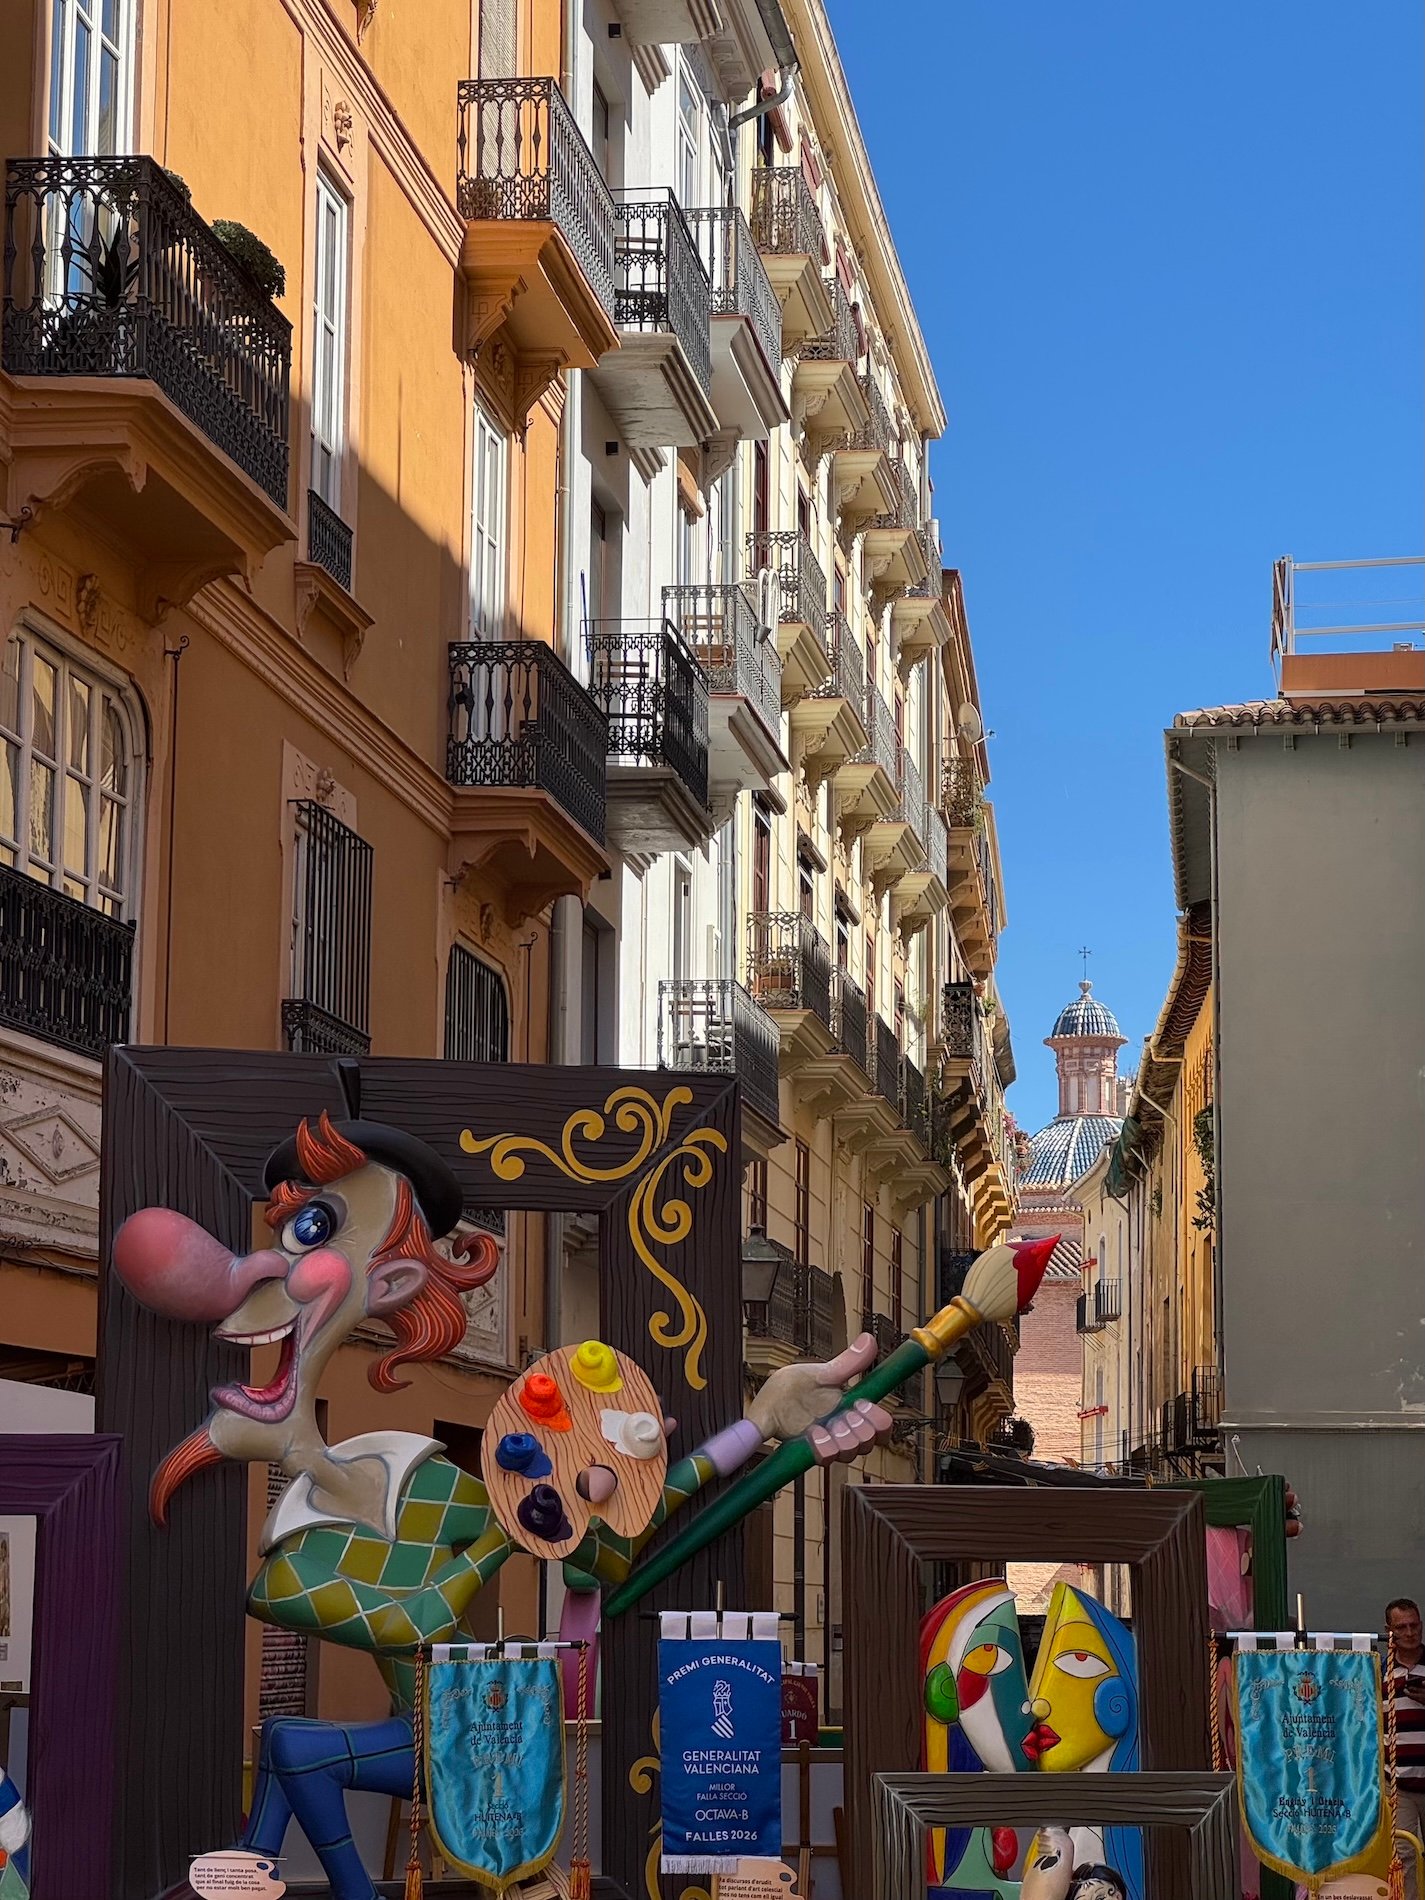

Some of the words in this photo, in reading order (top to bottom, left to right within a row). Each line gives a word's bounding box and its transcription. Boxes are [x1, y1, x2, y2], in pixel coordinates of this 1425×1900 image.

[667, 1660, 700, 1685] PREMI
[702, 1655, 775, 1684] GENERALITAT
[781, 1710, 807, 1720] UARDÓ
[1282, 1713, 1336, 1726] Ajuntament
[470, 1722, 523, 1733] Ajuntament
[789, 1719, 797, 1739] 1
[1283, 1728, 1293, 1738] de
[471, 1735, 481, 1745] de
[683, 1750, 761, 1761] GENERALITAT
[1284, 1745, 1337, 1764] PREMI
[684, 1763, 759, 1774] VALENCIANA
[1305, 1766, 1318, 1792] 1
[719, 1792, 747, 1800] SECCIÓ
[695, 1809, 748, 1821] OCTAVA-B
[686, 1831, 728, 1841] FALLES
[731, 1830, 757, 1840] 2026
